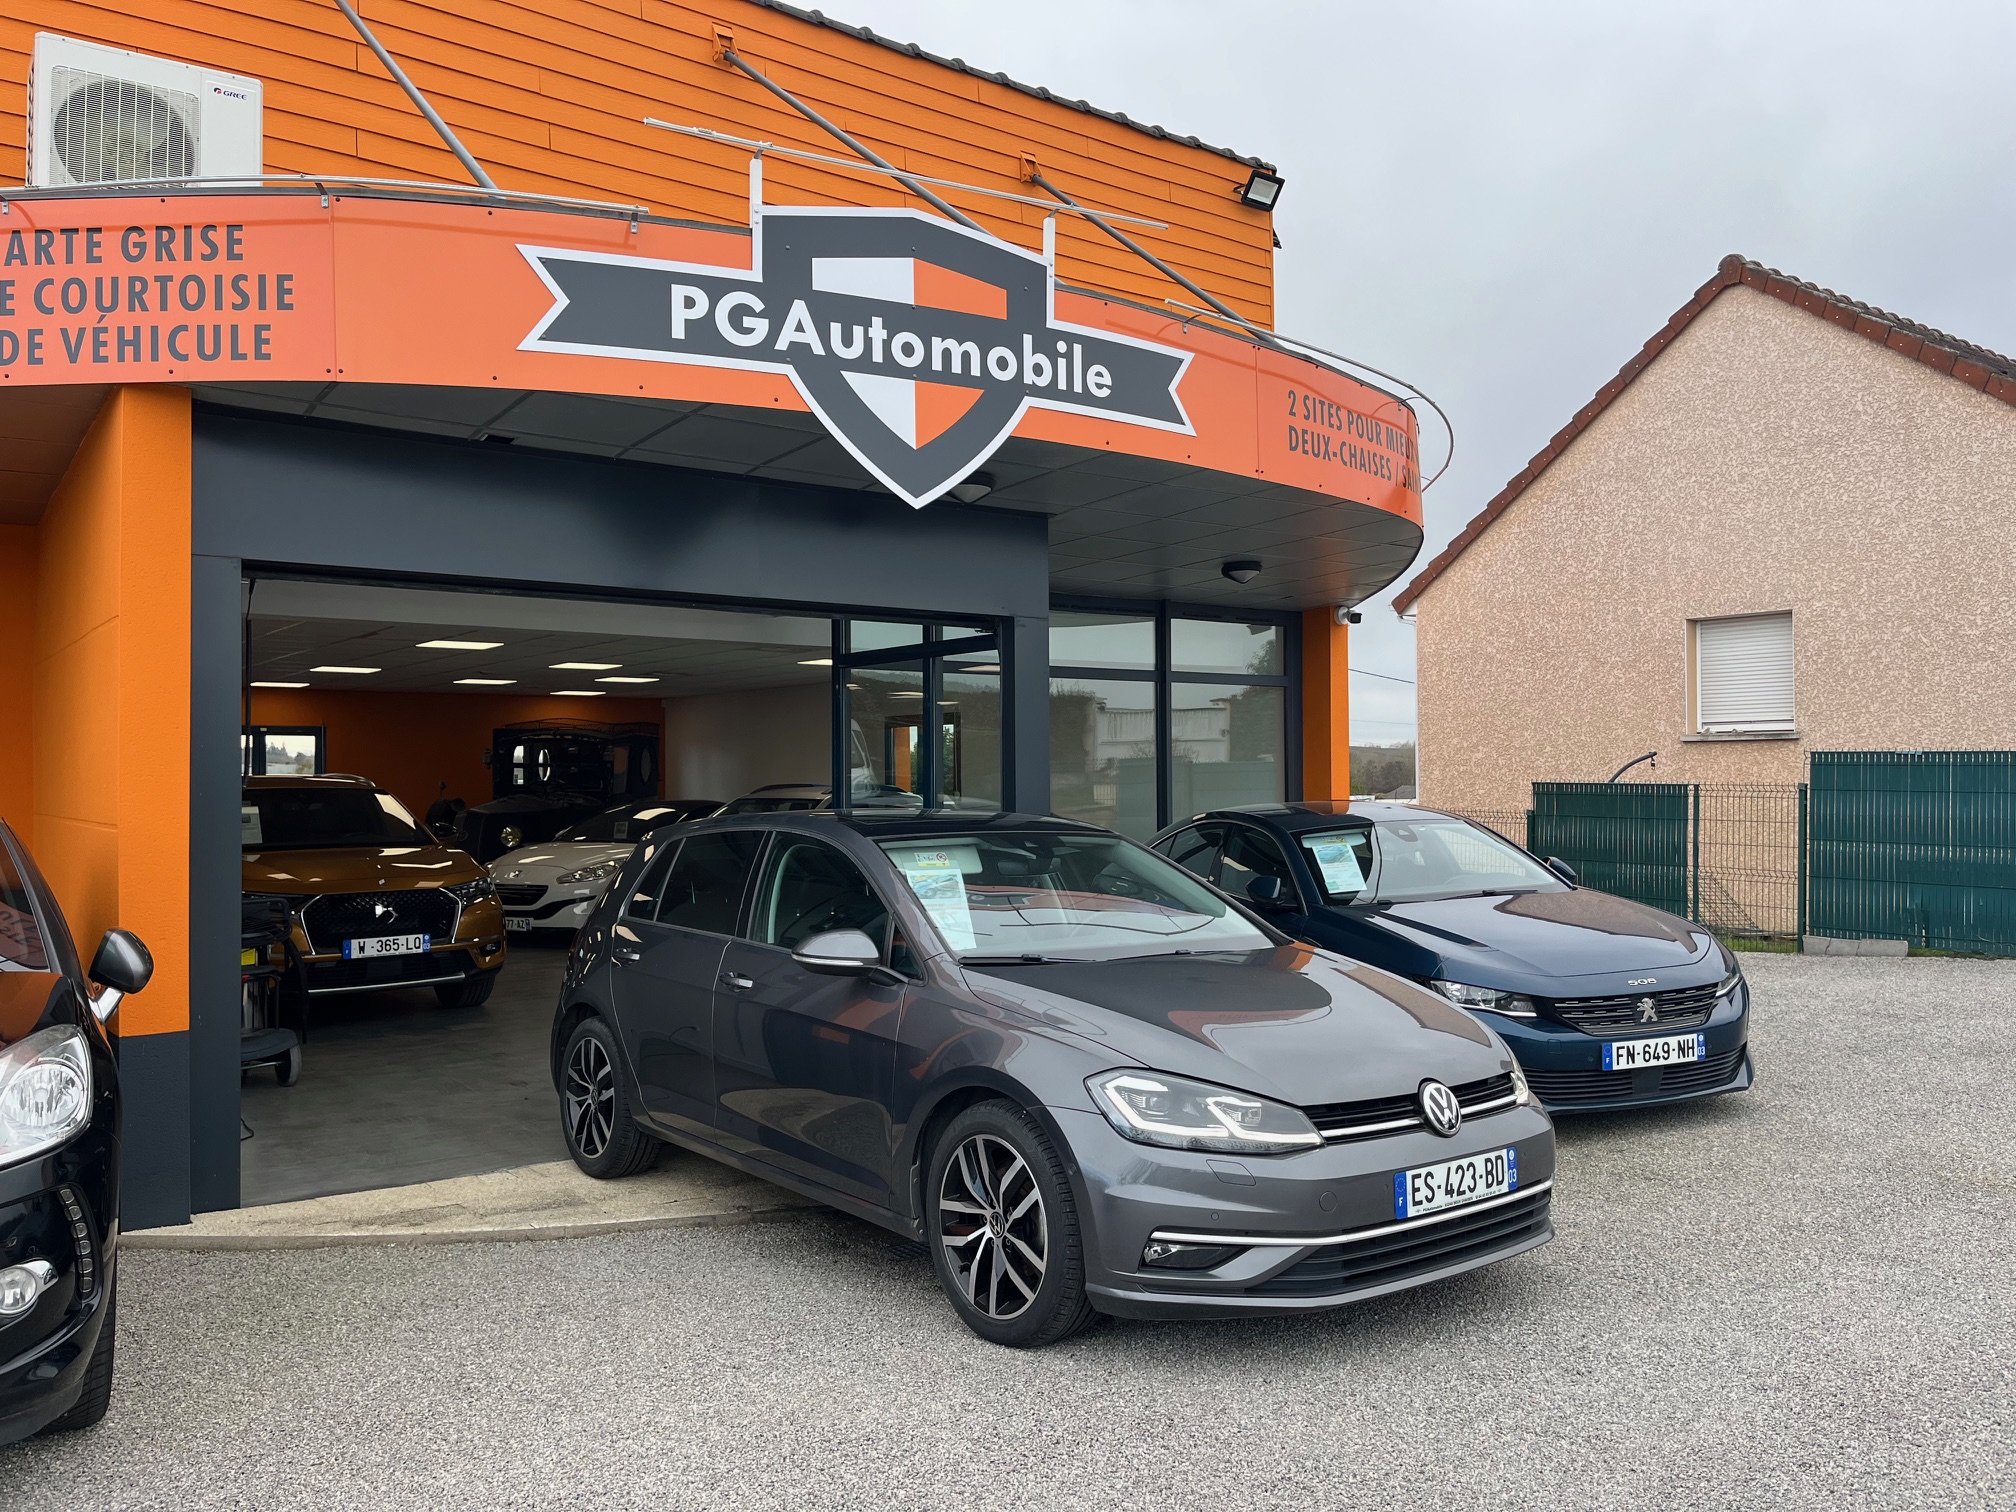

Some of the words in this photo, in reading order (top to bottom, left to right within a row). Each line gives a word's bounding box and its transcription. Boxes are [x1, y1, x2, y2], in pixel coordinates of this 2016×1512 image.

[223, 90, 247, 100] GREE
[4, 228, 103, 266] ARTE
[121, 224, 243, 263] GRISE
[0, 279, 15, 316] E
[33, 274, 294, 315] COURTOISIE
[0, 329, 44, 366] DE
[60, 314, 272, 364] VÉHICULE
[670, 283, 1113, 398] PGAutomobile
[1288, 389, 1297, 418] 2
[1302, 394, 1343, 432] SITES
[1347, 409, 1383, 446] POUR
[1288, 424, 1392, 482] DEUX-CHAISES
[1616, 1038, 1696, 1066] FN-649-NH
[1697, 1046, 1706, 1056] 03
[1398, 1197, 1404, 1207] F
[1411, 1154, 1505, 1208] ES-423-BD
[1508, 1168, 1518, 1184] 03
